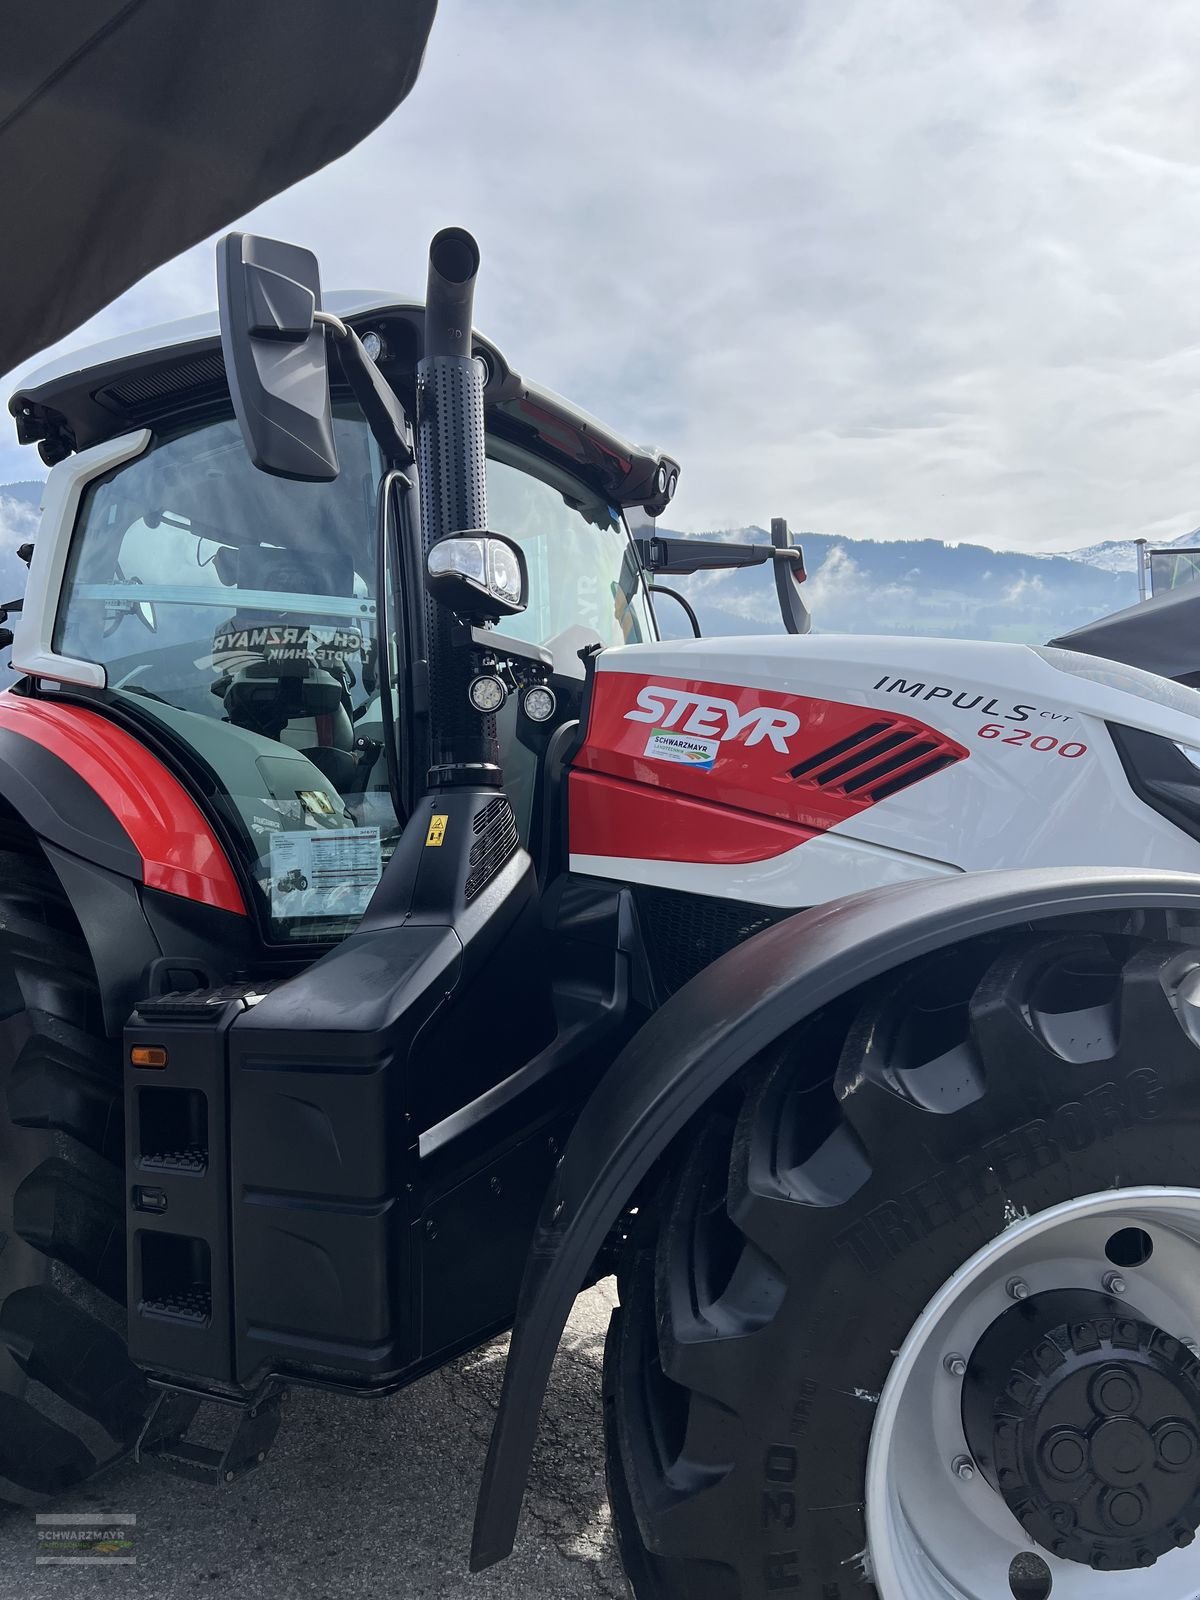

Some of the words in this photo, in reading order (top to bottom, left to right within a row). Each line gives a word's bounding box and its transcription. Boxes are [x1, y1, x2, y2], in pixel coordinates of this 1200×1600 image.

[623, 685, 801, 755] STEYR
[873, 676, 1037, 722] IMPULS
[1039, 711, 1074, 723] CVT
[654, 735, 708, 753] SCHWARZMAYR
[977, 723, 1088, 758] 6200
[832, 1067, 1167, 1273] TRELLEBORG
